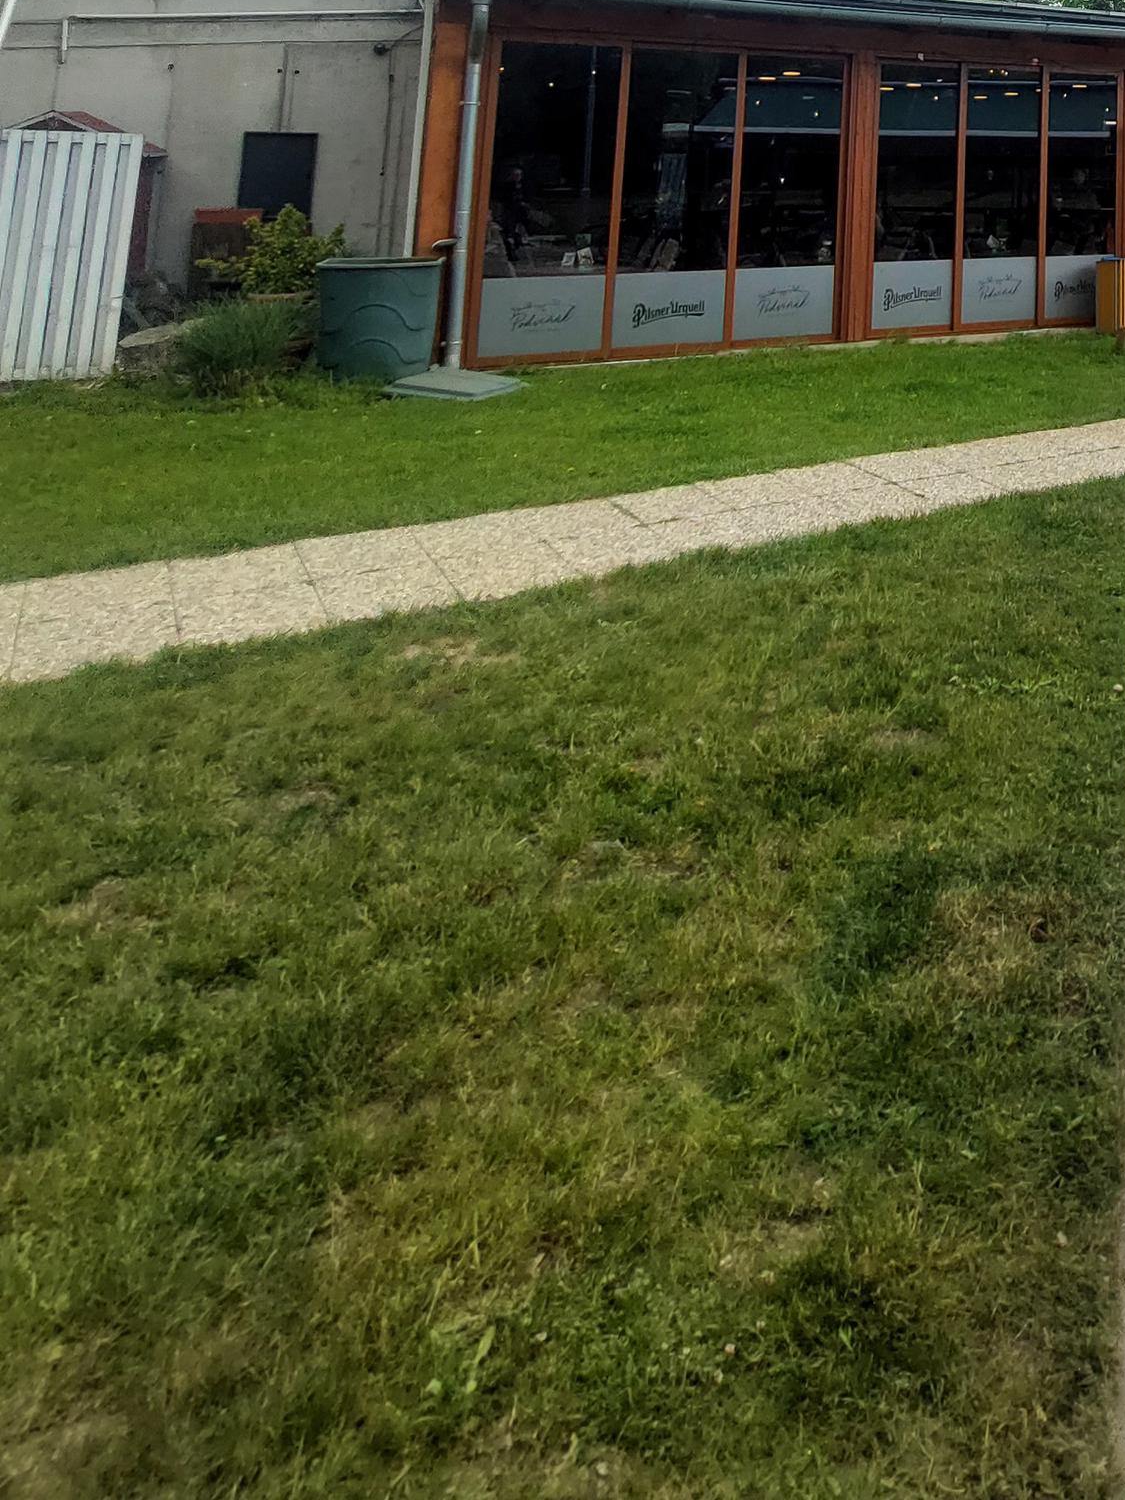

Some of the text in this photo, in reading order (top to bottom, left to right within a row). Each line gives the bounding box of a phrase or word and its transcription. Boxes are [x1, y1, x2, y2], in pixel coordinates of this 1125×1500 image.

[883, 286, 942, 311] Pilsner Urquell
[632, 300, 705, 328] Pilsner Urquell
